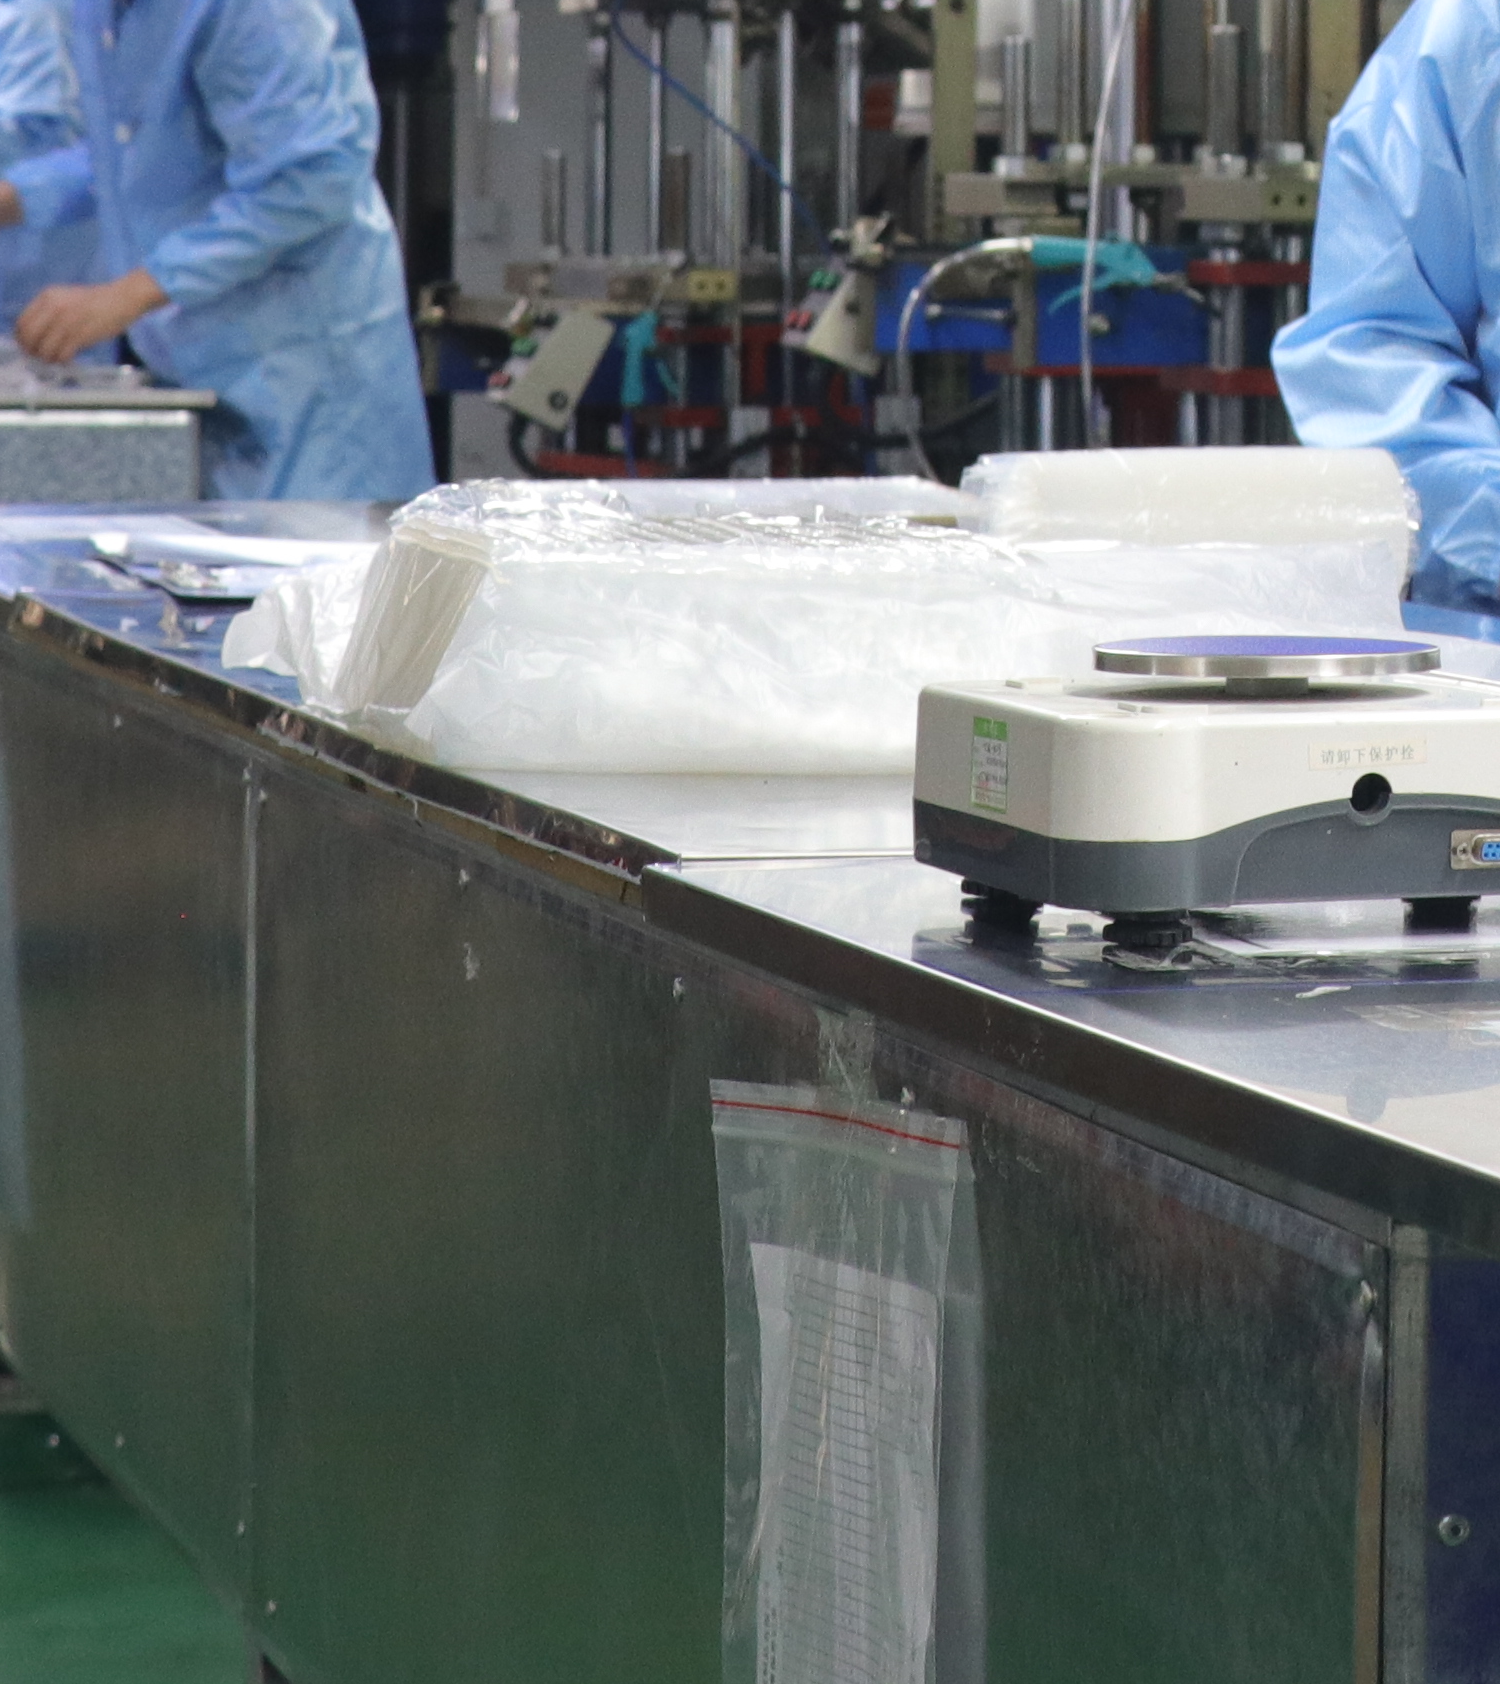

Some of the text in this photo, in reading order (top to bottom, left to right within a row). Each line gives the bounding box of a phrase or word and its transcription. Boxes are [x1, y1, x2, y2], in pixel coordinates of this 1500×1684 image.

[1320, 744, 1415, 765] 请卸下保护栓
